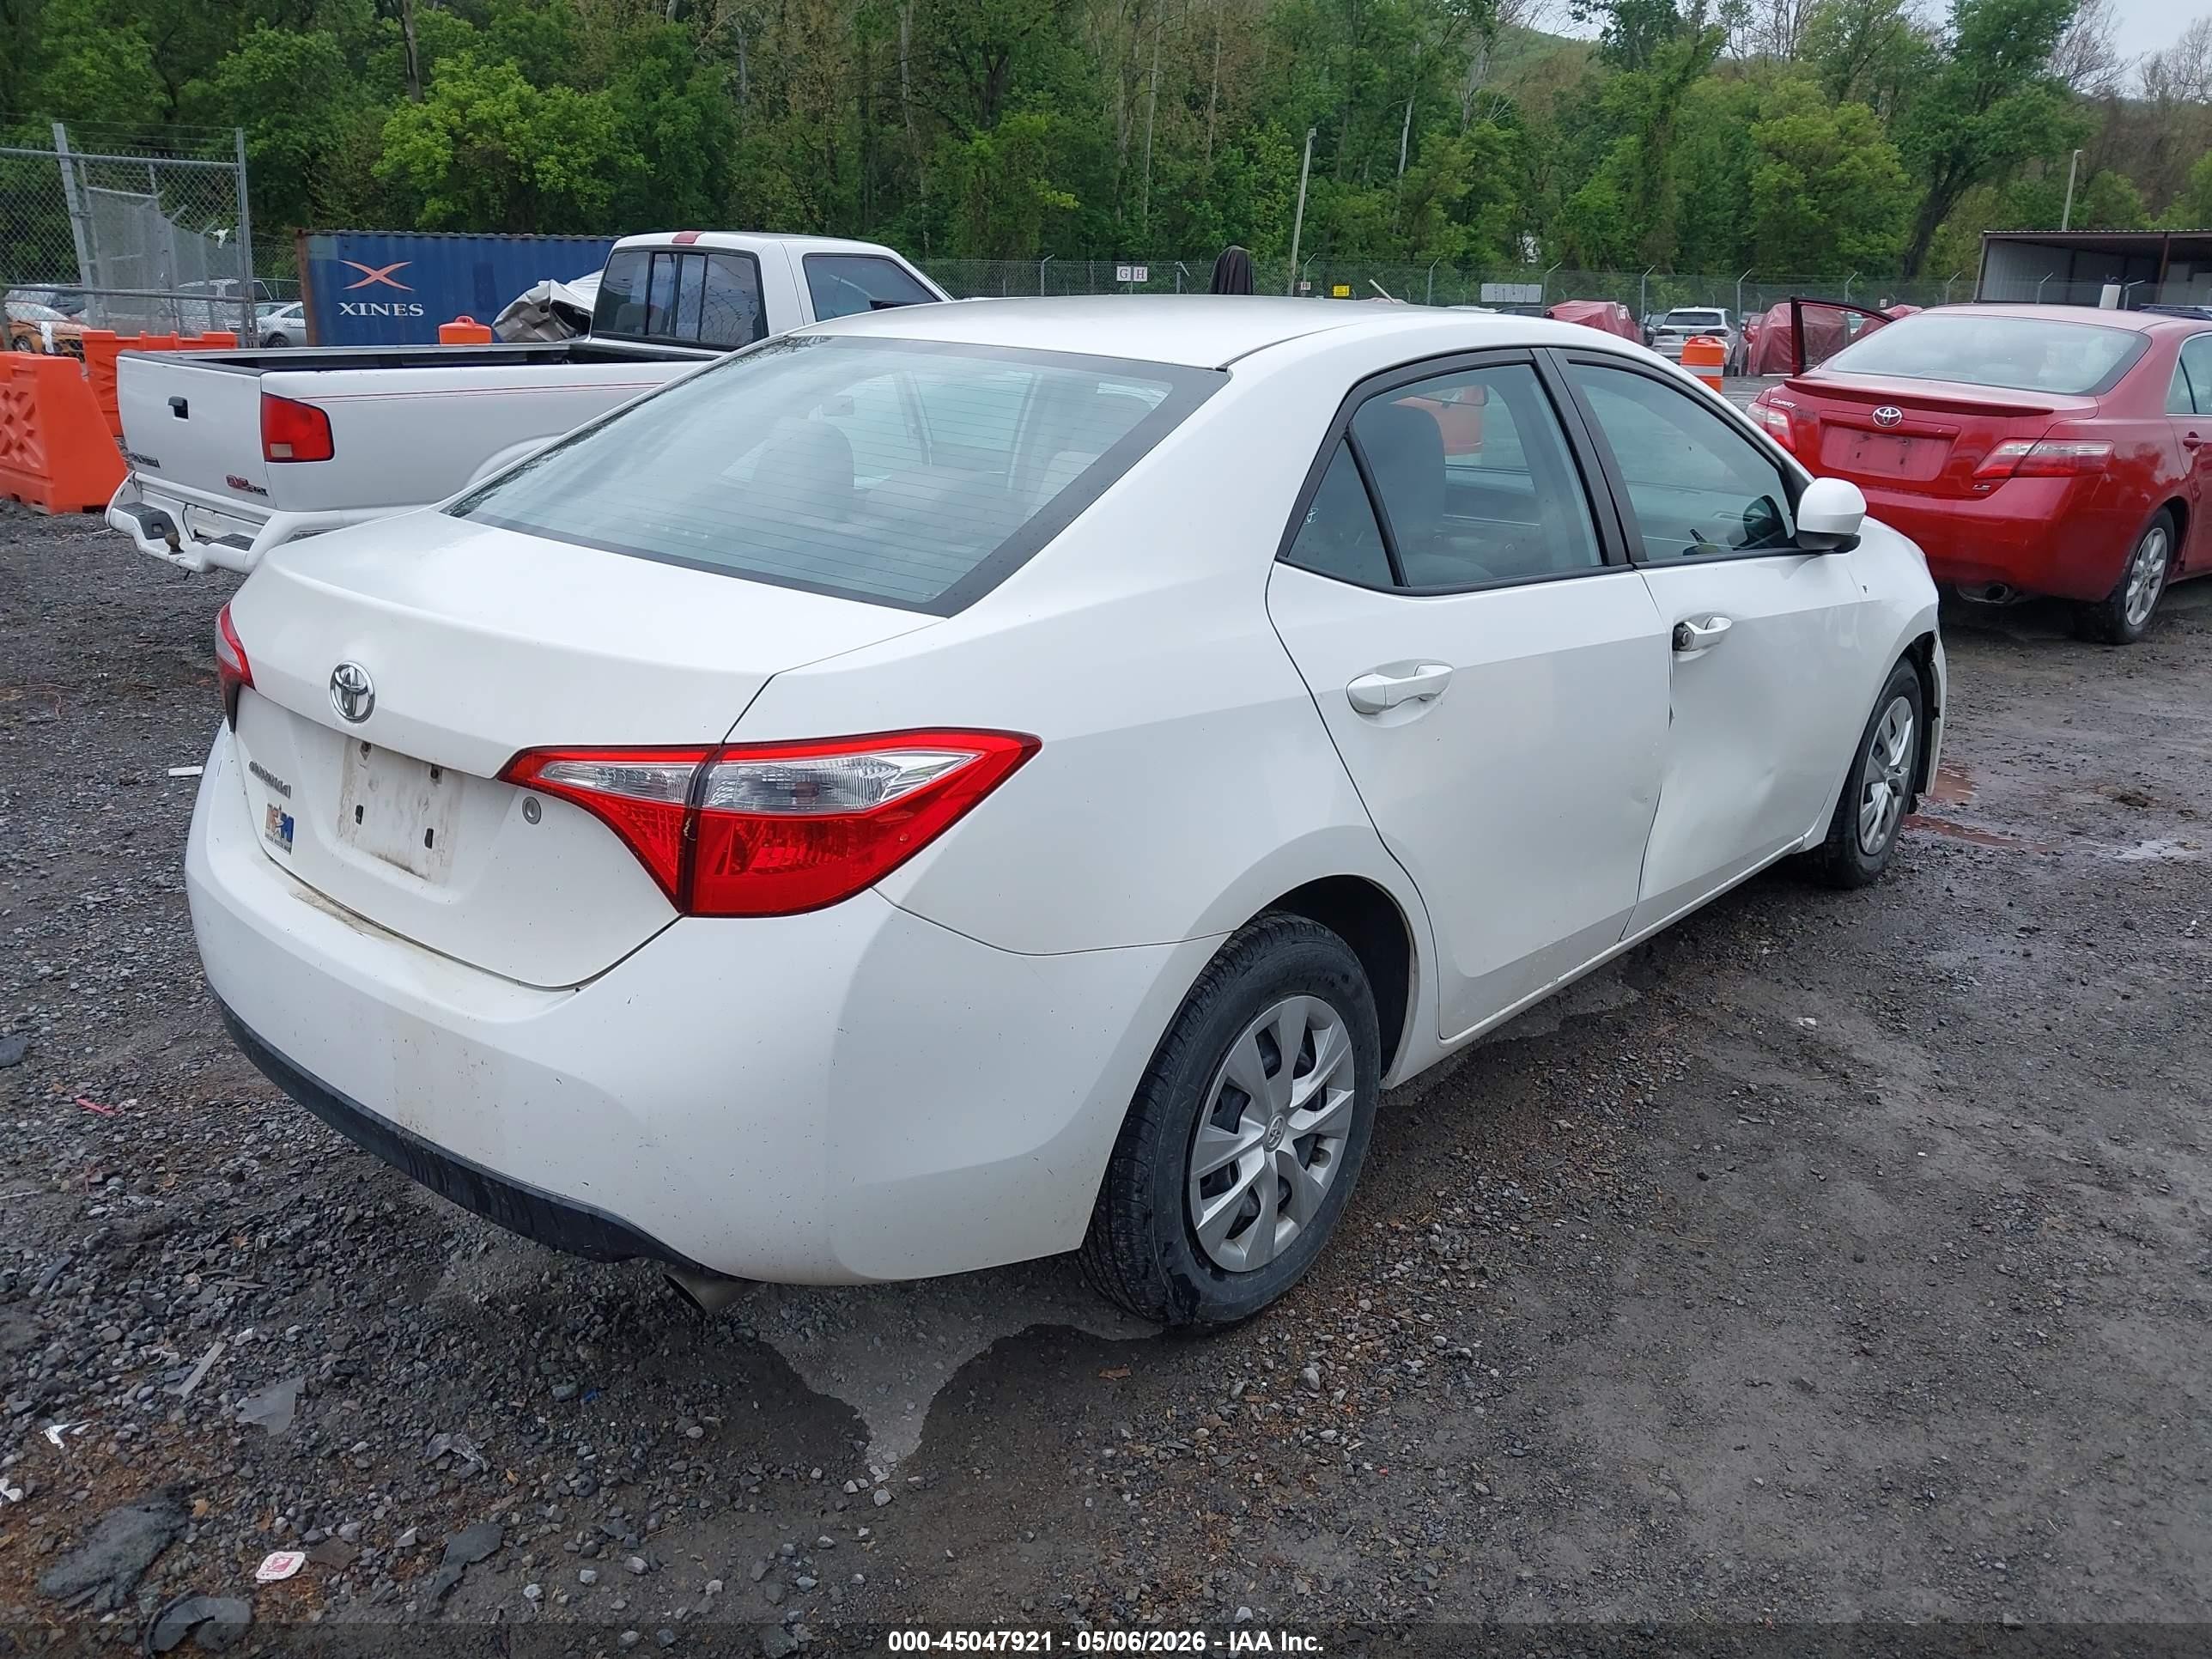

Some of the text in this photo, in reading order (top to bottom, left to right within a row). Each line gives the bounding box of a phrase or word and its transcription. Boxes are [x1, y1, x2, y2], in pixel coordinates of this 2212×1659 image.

[1120, 268, 1127, 279] G
[1137, 269, 1145, 279] H
[337, 302, 424, 317] XINES
